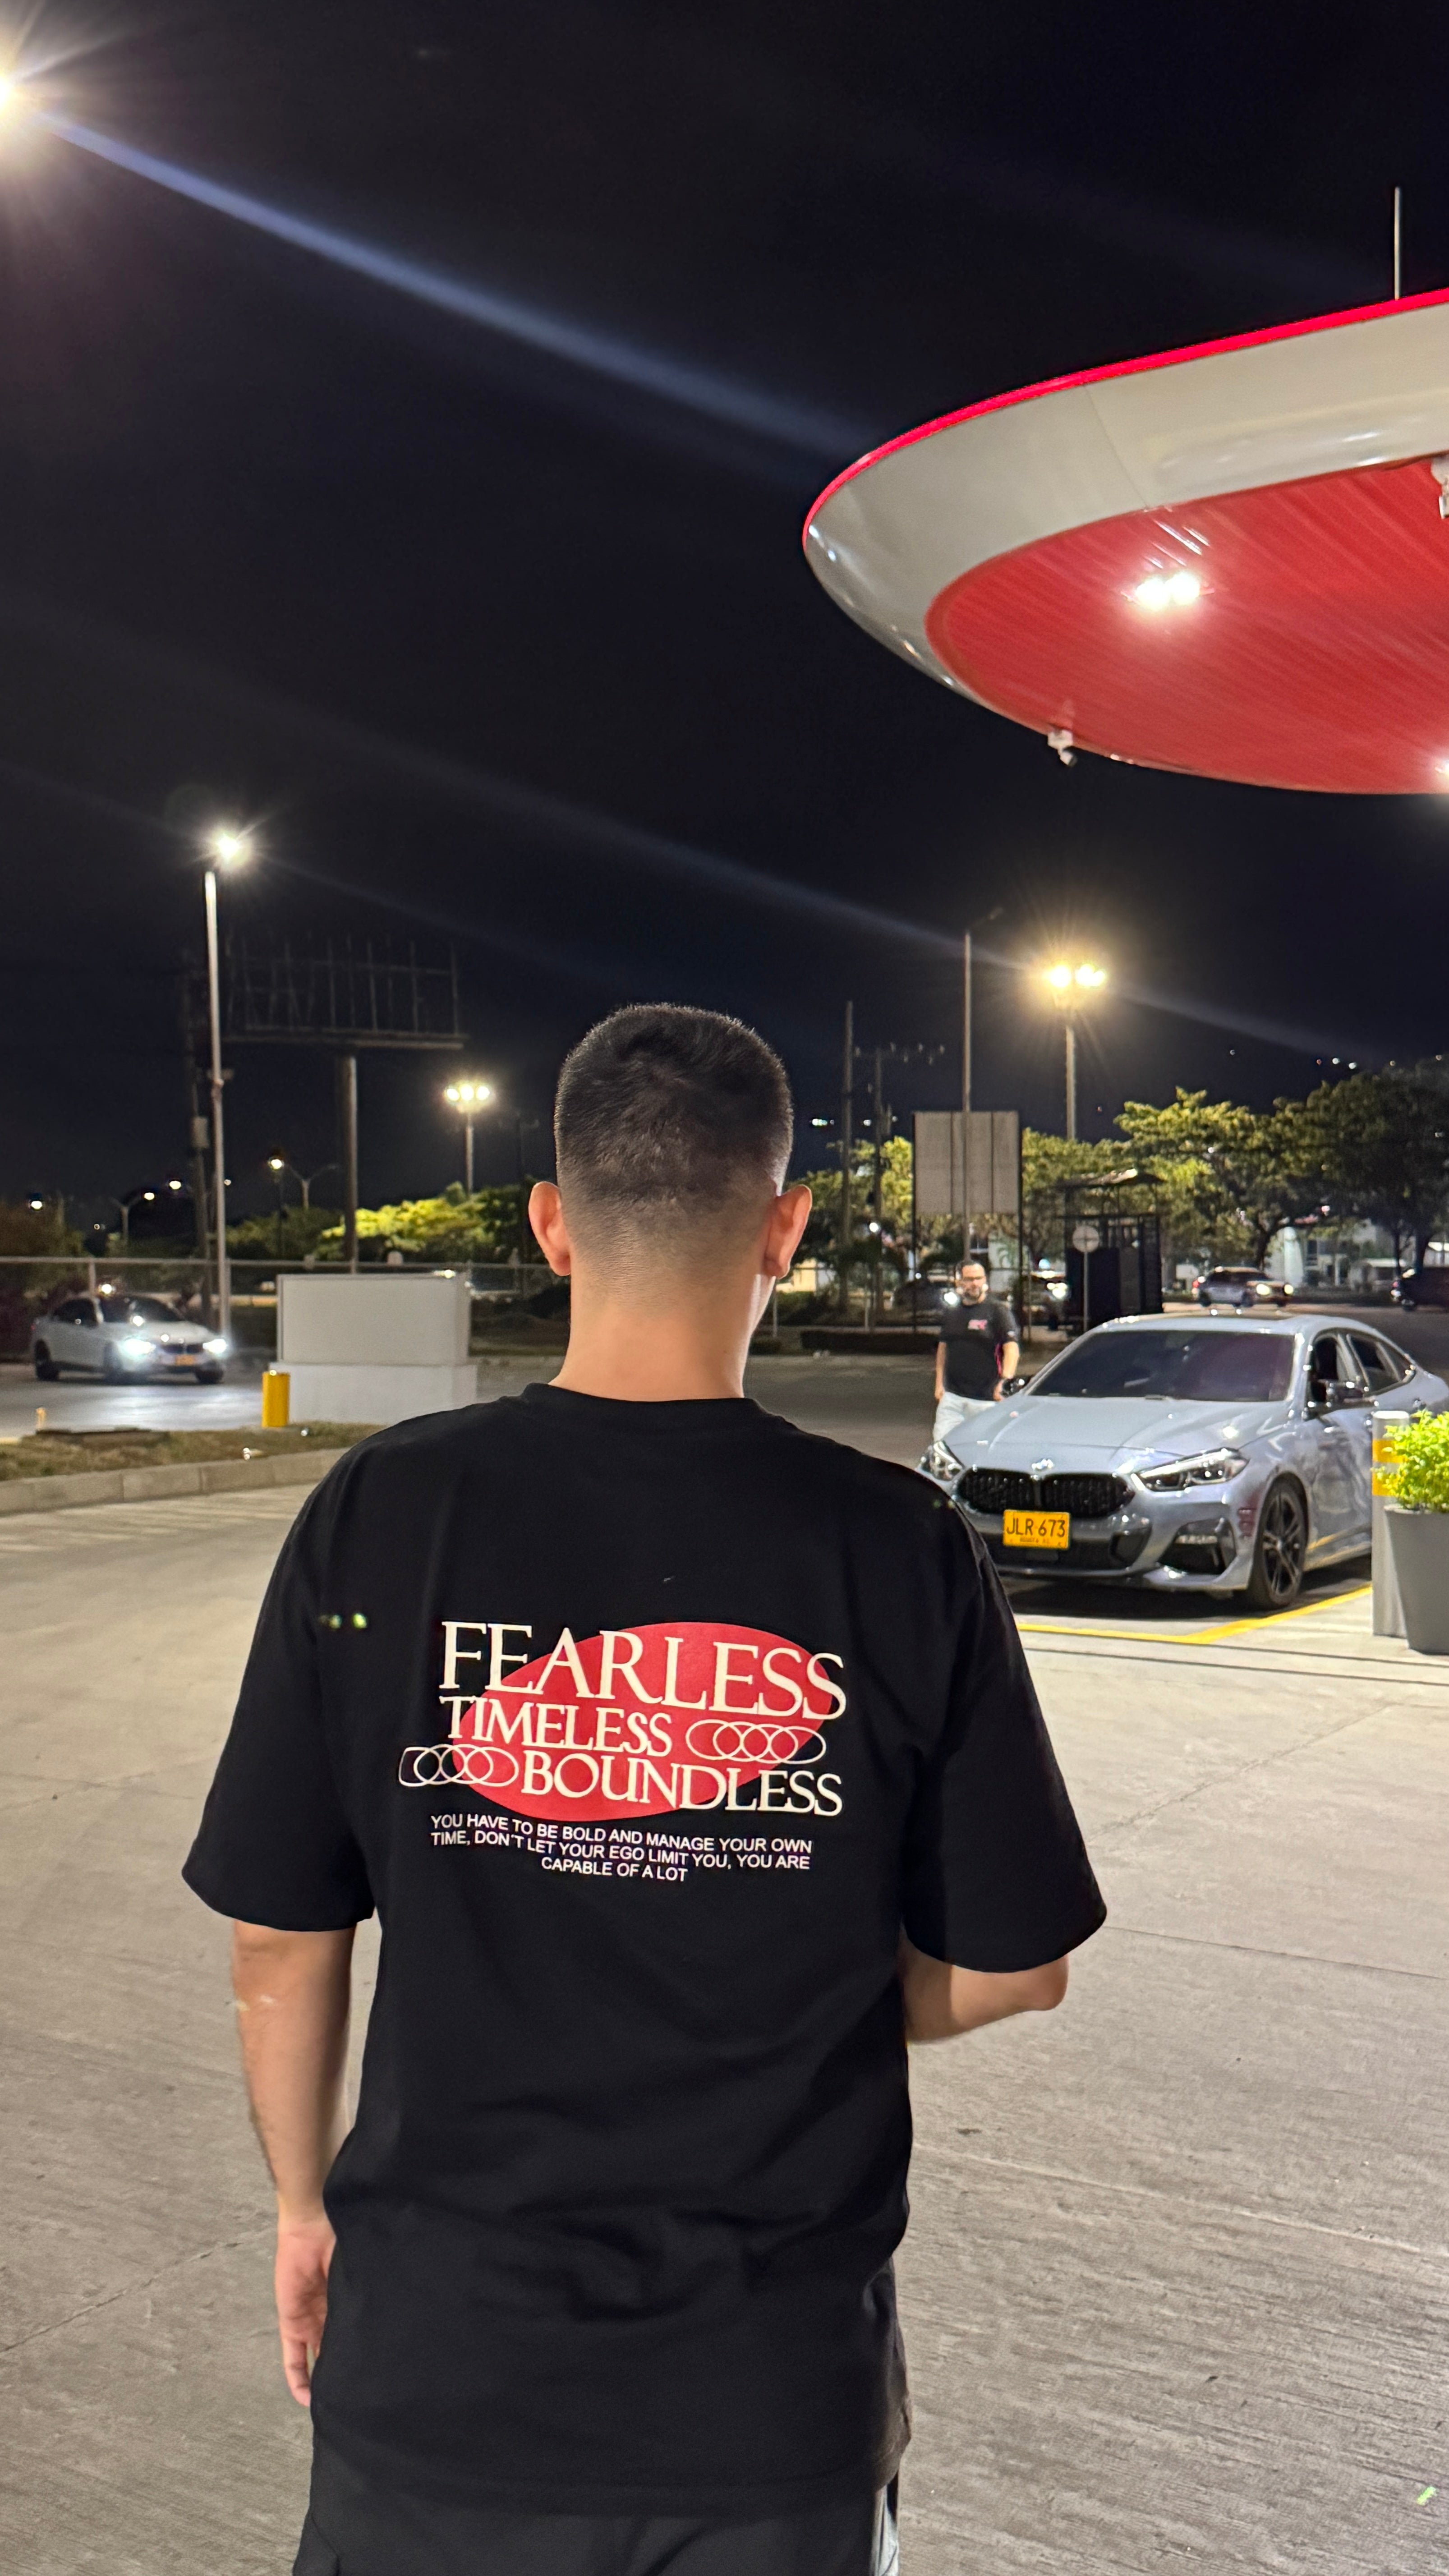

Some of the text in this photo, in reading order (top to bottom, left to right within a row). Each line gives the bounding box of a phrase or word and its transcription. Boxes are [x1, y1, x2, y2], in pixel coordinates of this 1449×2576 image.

[1007, 1518, 1065, 1537] JLR 673
[439, 1621, 846, 1720] FEARLESS
[440, 1695, 673, 1757] TIMELESS
[522, 1750, 842, 1817] BOUNDLESS
[431, 1814, 812, 1853] YOU HAVE TO BE BOLD AND MANAGE YOUR OWN
[431, 1830, 810, 1870] TIME, DON'T LET YOUR EGO LIMIT YOU, YOU ARE
[541, 1857, 688, 1882] CAPABLE OF A LOT
